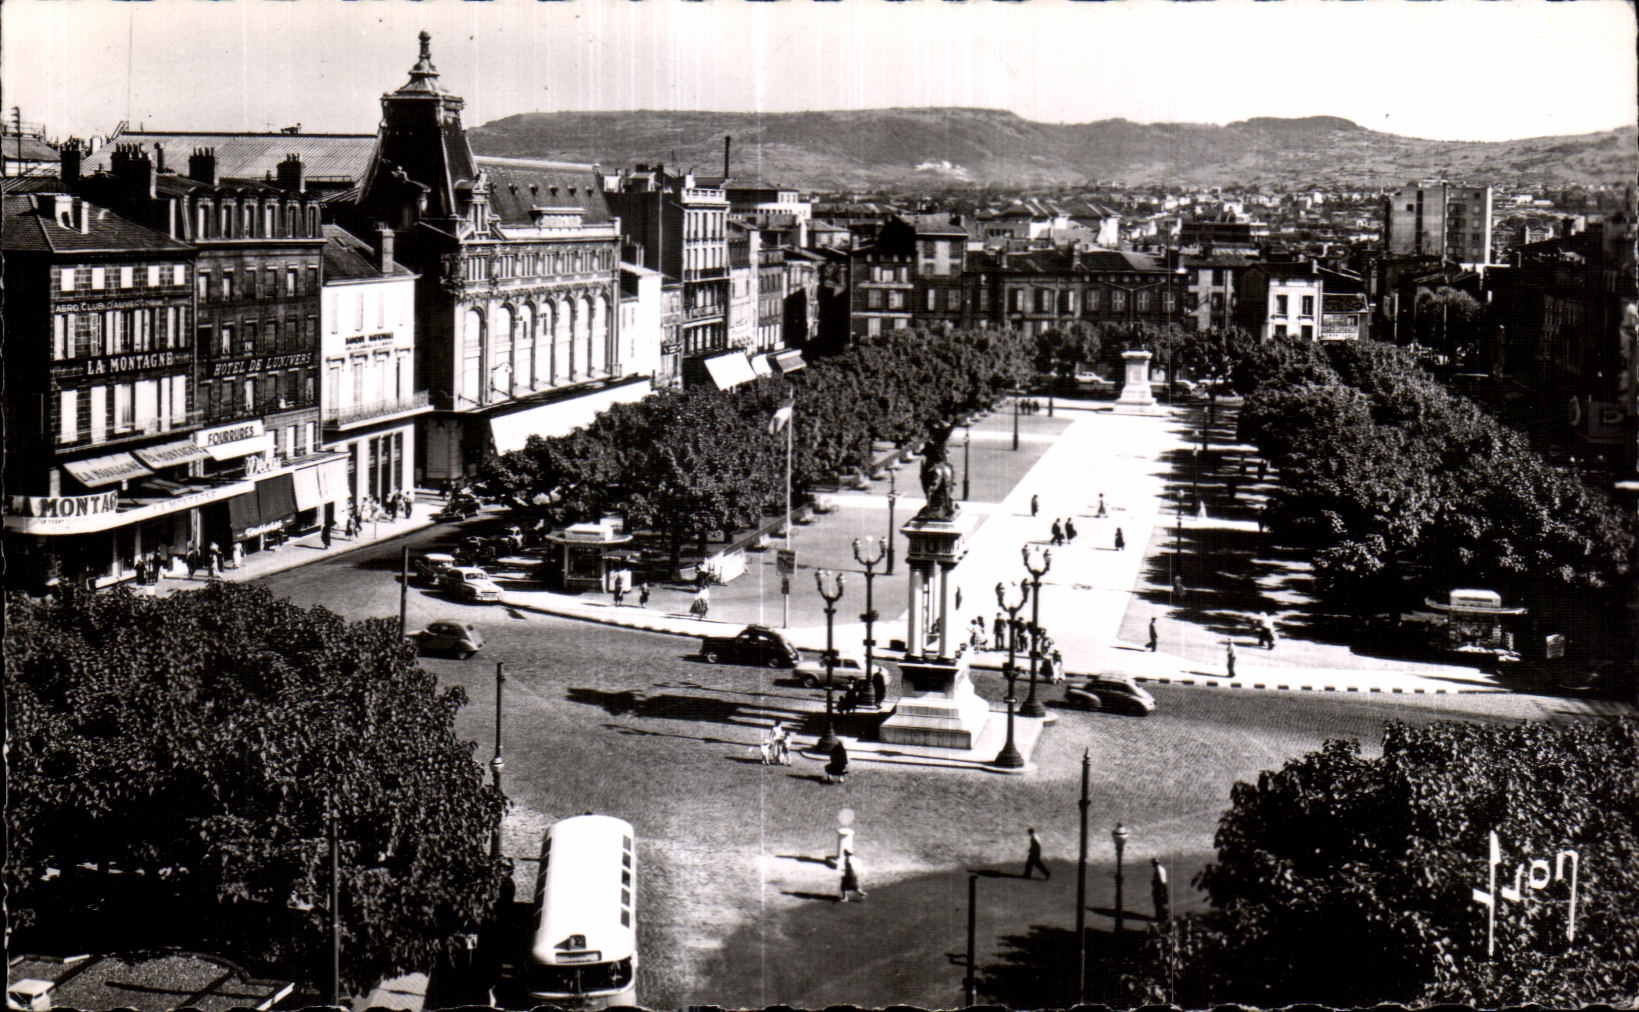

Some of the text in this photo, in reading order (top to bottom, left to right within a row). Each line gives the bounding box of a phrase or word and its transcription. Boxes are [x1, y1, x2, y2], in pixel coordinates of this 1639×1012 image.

[81, 302, 105, 311] CLUB
[87, 352, 173, 375] LA MONTAGNE
[248, 358, 264, 372] DE
[208, 425, 254, 447] FOURRURES
